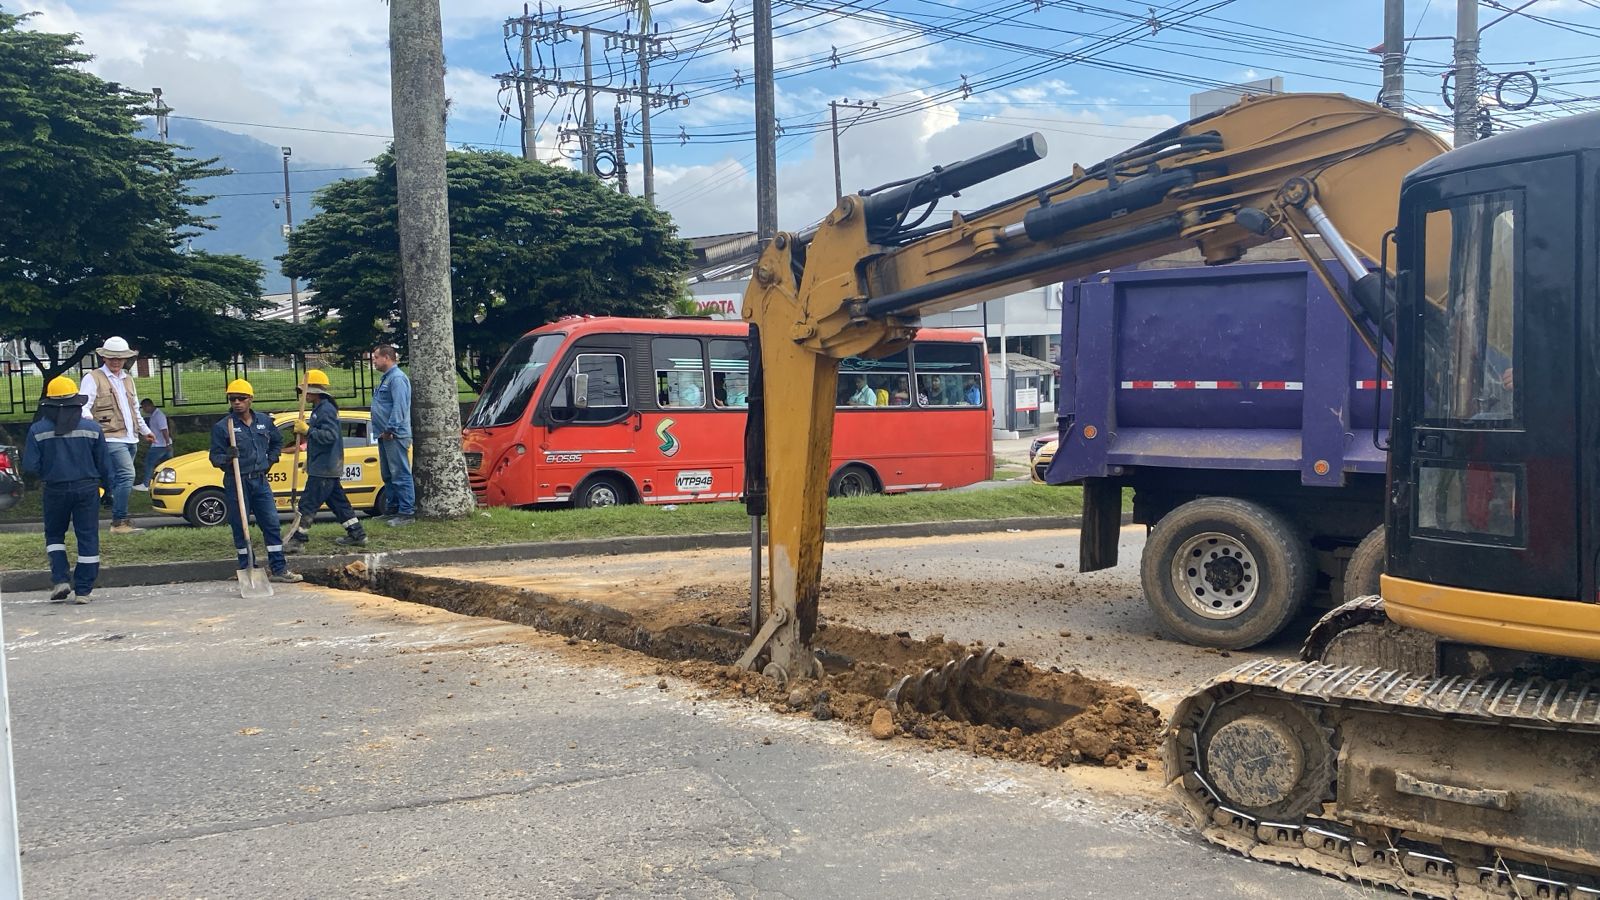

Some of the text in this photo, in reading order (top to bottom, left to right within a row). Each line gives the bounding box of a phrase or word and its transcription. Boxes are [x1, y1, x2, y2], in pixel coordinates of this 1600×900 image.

[695, 300, 736, 314] OYOTA
[346, 466, 361, 477] 843
[267, 472, 287, 482] 553
[675, 476, 713, 486] WTP948
